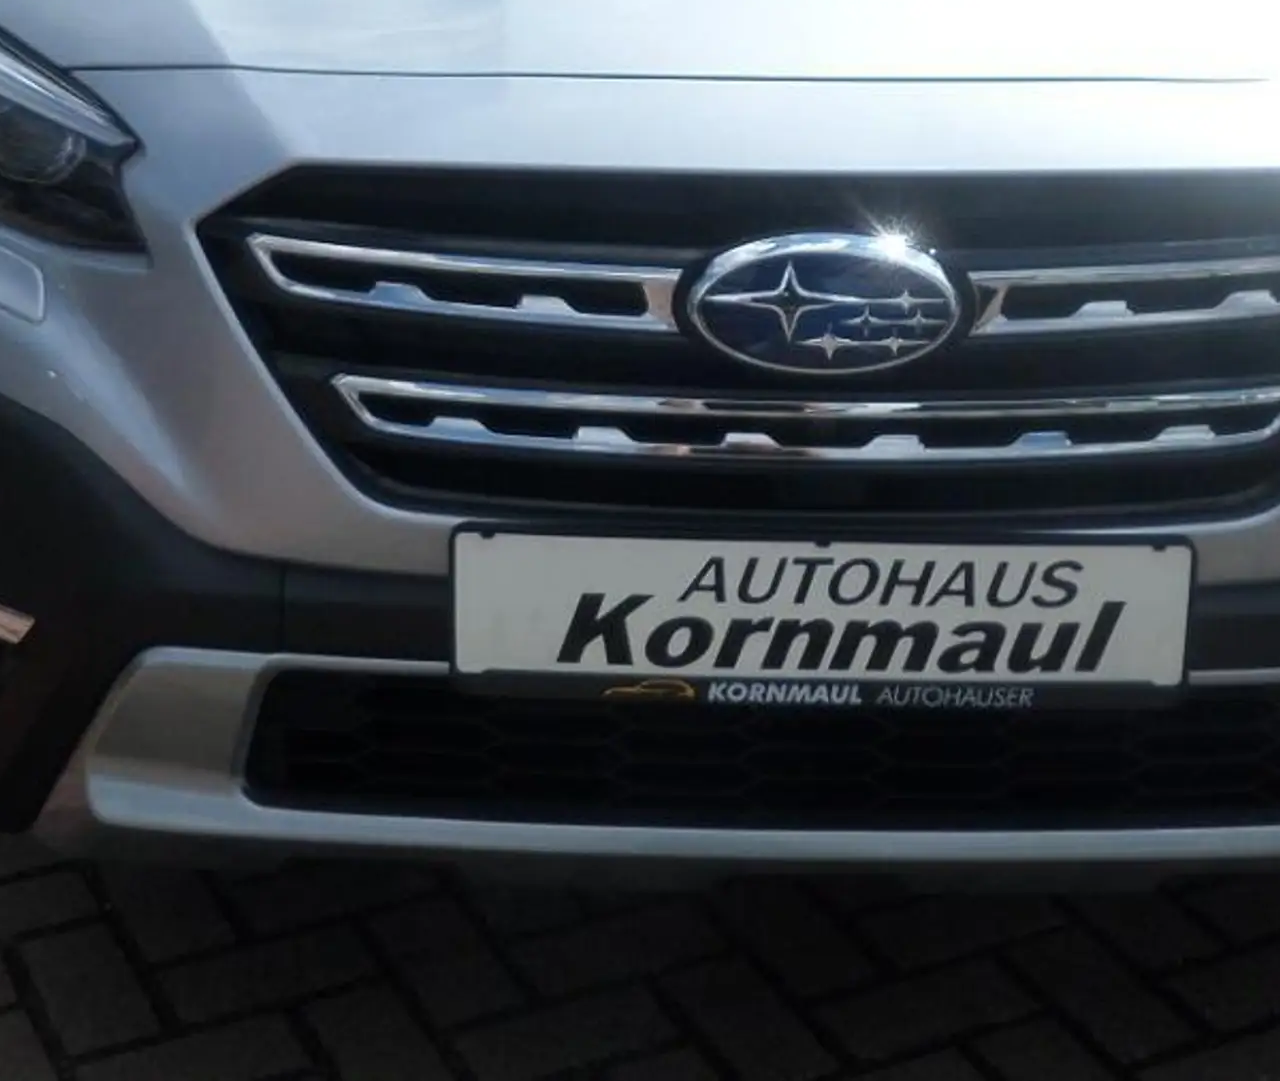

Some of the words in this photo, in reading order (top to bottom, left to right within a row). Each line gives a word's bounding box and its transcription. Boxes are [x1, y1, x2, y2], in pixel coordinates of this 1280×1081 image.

[678, 556, 1085, 608] AUTOHAUS
[556, 592, 1127, 673] Kornmaul
[708, 683, 863, 706] KORNMAUL
